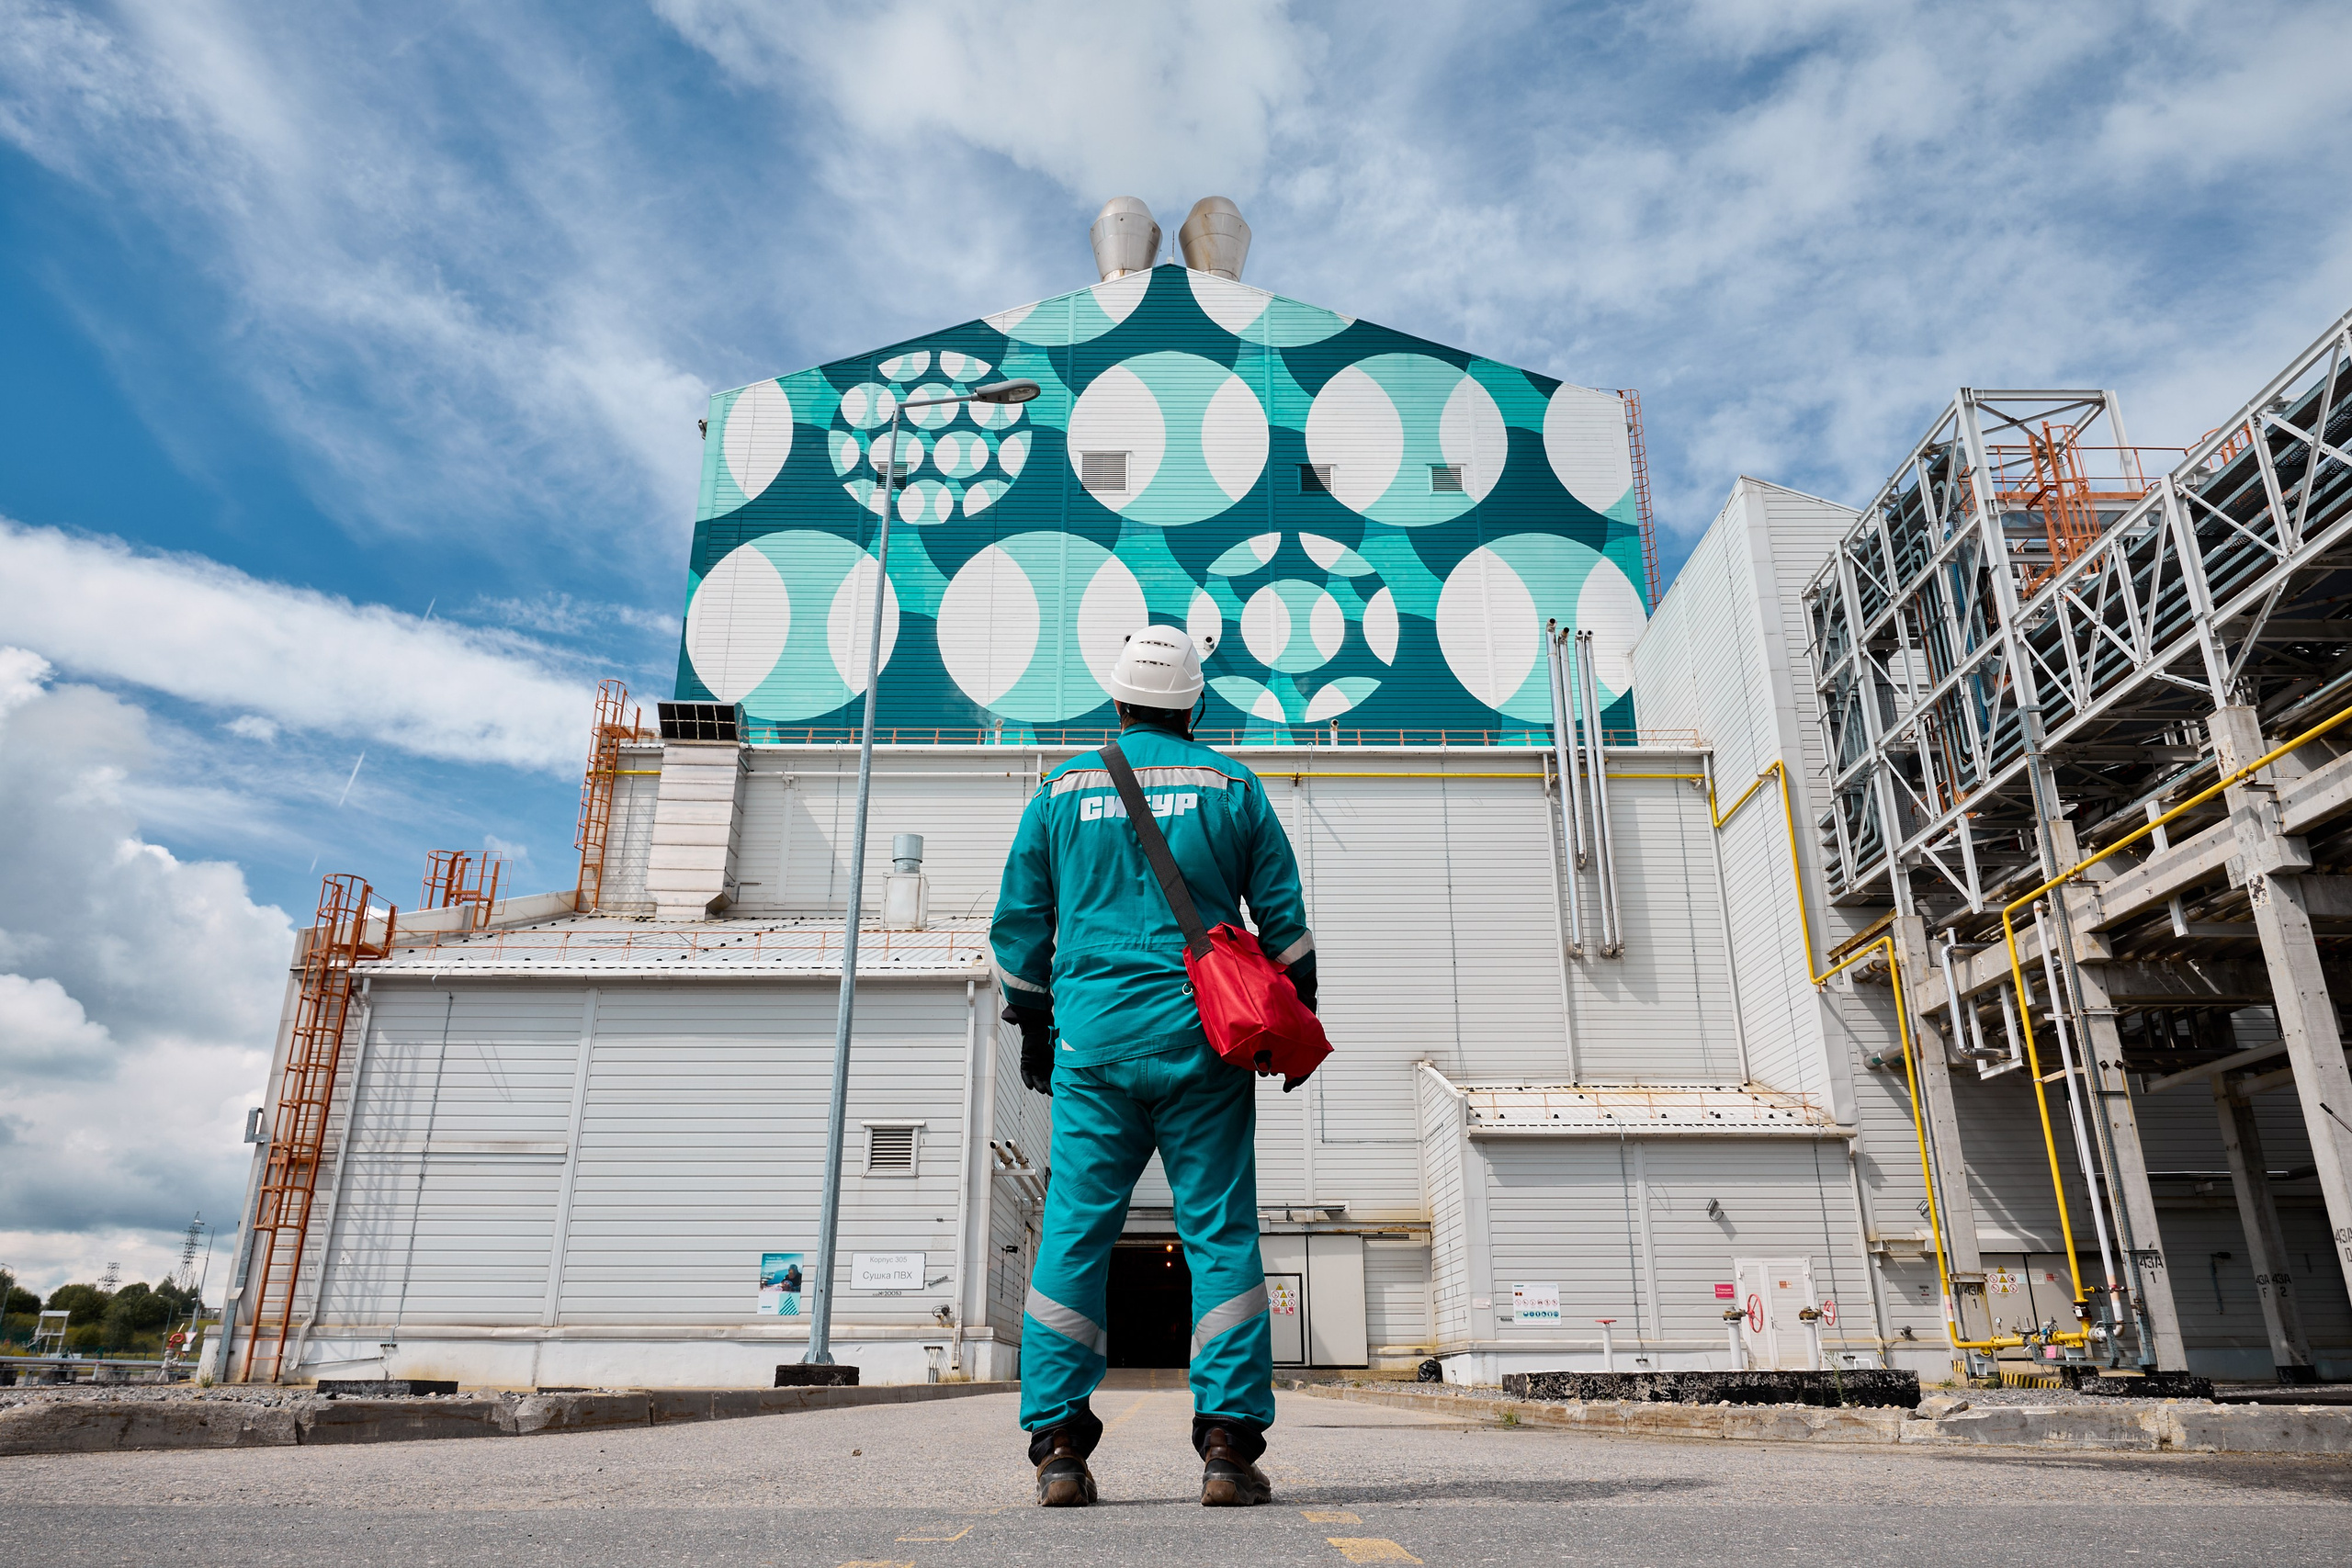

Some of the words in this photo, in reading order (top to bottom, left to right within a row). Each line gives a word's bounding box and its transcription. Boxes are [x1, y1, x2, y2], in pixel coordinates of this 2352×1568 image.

[1080, 793, 1198, 822] СИУР
[2139, 1256, 2164, 1269] 43A
[863, 1270, 891, 1280] Сушка
[893, 1270, 913, 1280] ПВХ
[2150, 1270, 2156, 1283] 1
[2256, 1273, 2270, 1285] 43A
[2271, 1272, 2292, 1284] 43A
[1964, 1285, 1984, 1296] 43A
[2279, 1286, 2288, 1297] 2
[1973, 1298, 1978, 1309] 1
